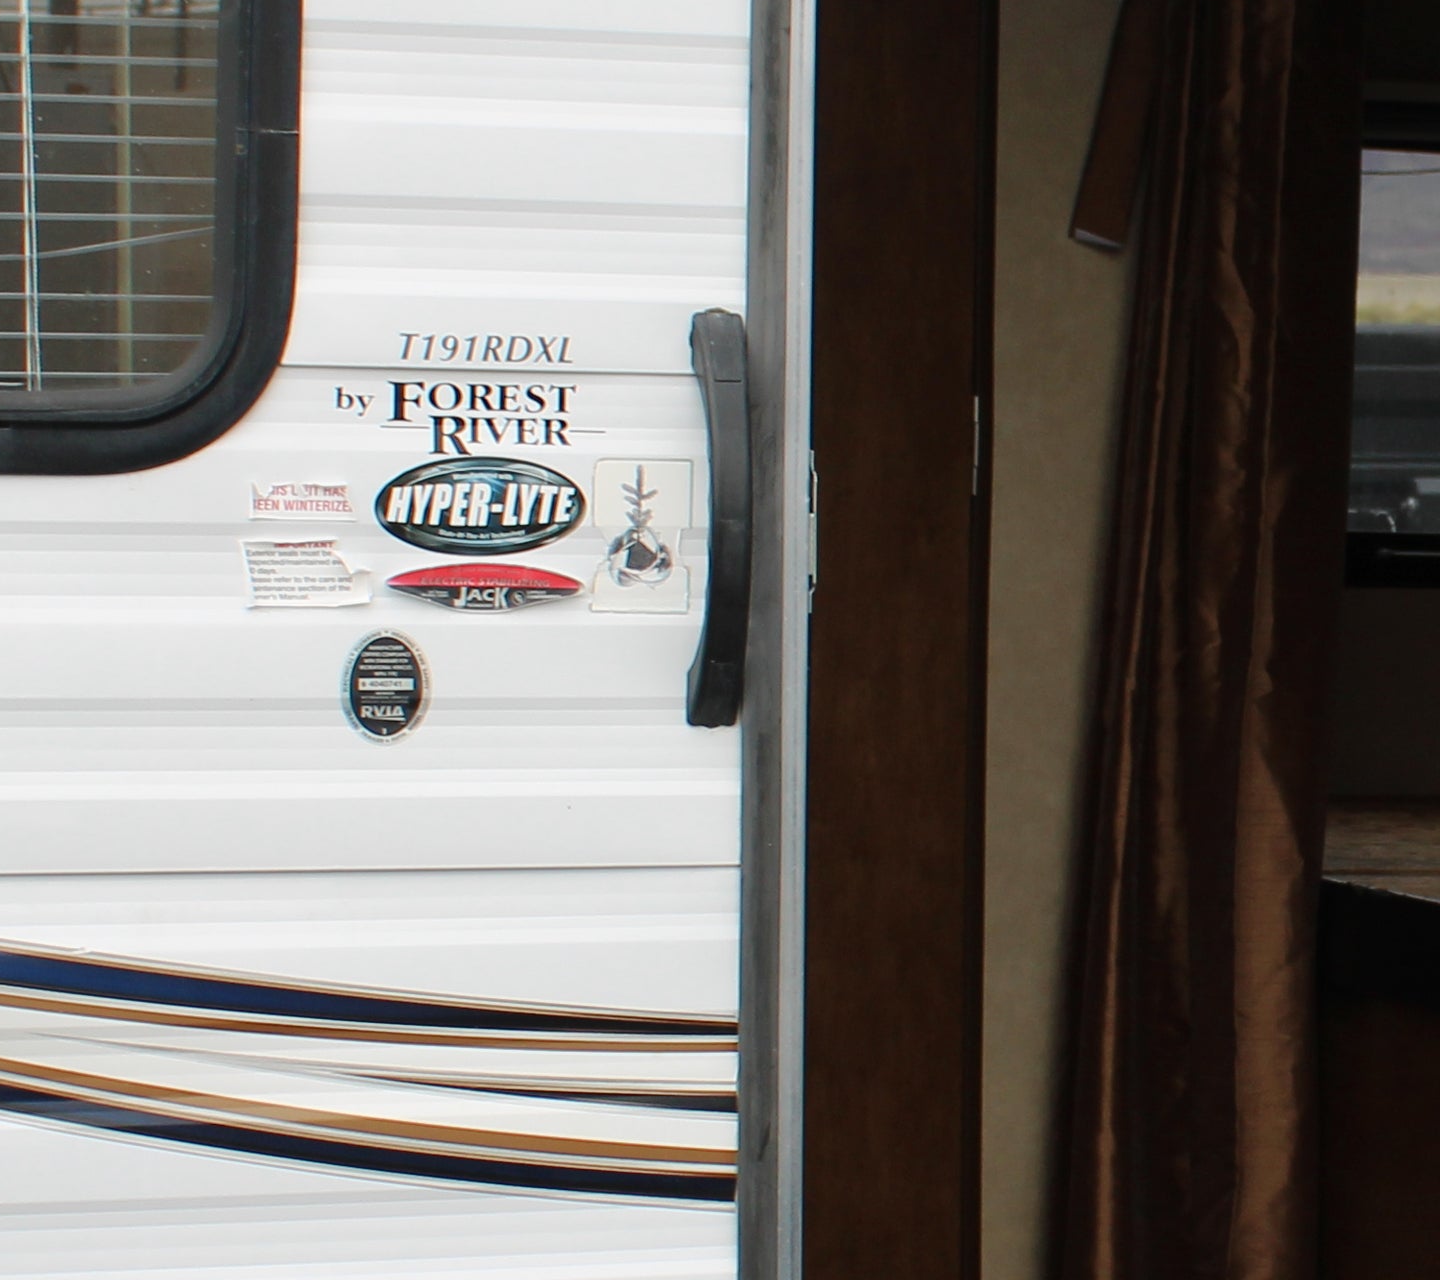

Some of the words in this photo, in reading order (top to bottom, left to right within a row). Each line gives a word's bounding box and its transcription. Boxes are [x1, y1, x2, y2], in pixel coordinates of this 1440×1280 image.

[399, 332, 575, 365] T191RDXL
[334, 386, 375, 417] by
[386, 380, 578, 423] FOREST
[428, 414, 573, 456] RIVER
[385, 482, 577, 528] HYPER-LYTE
[453, 586, 510, 608] JACK
